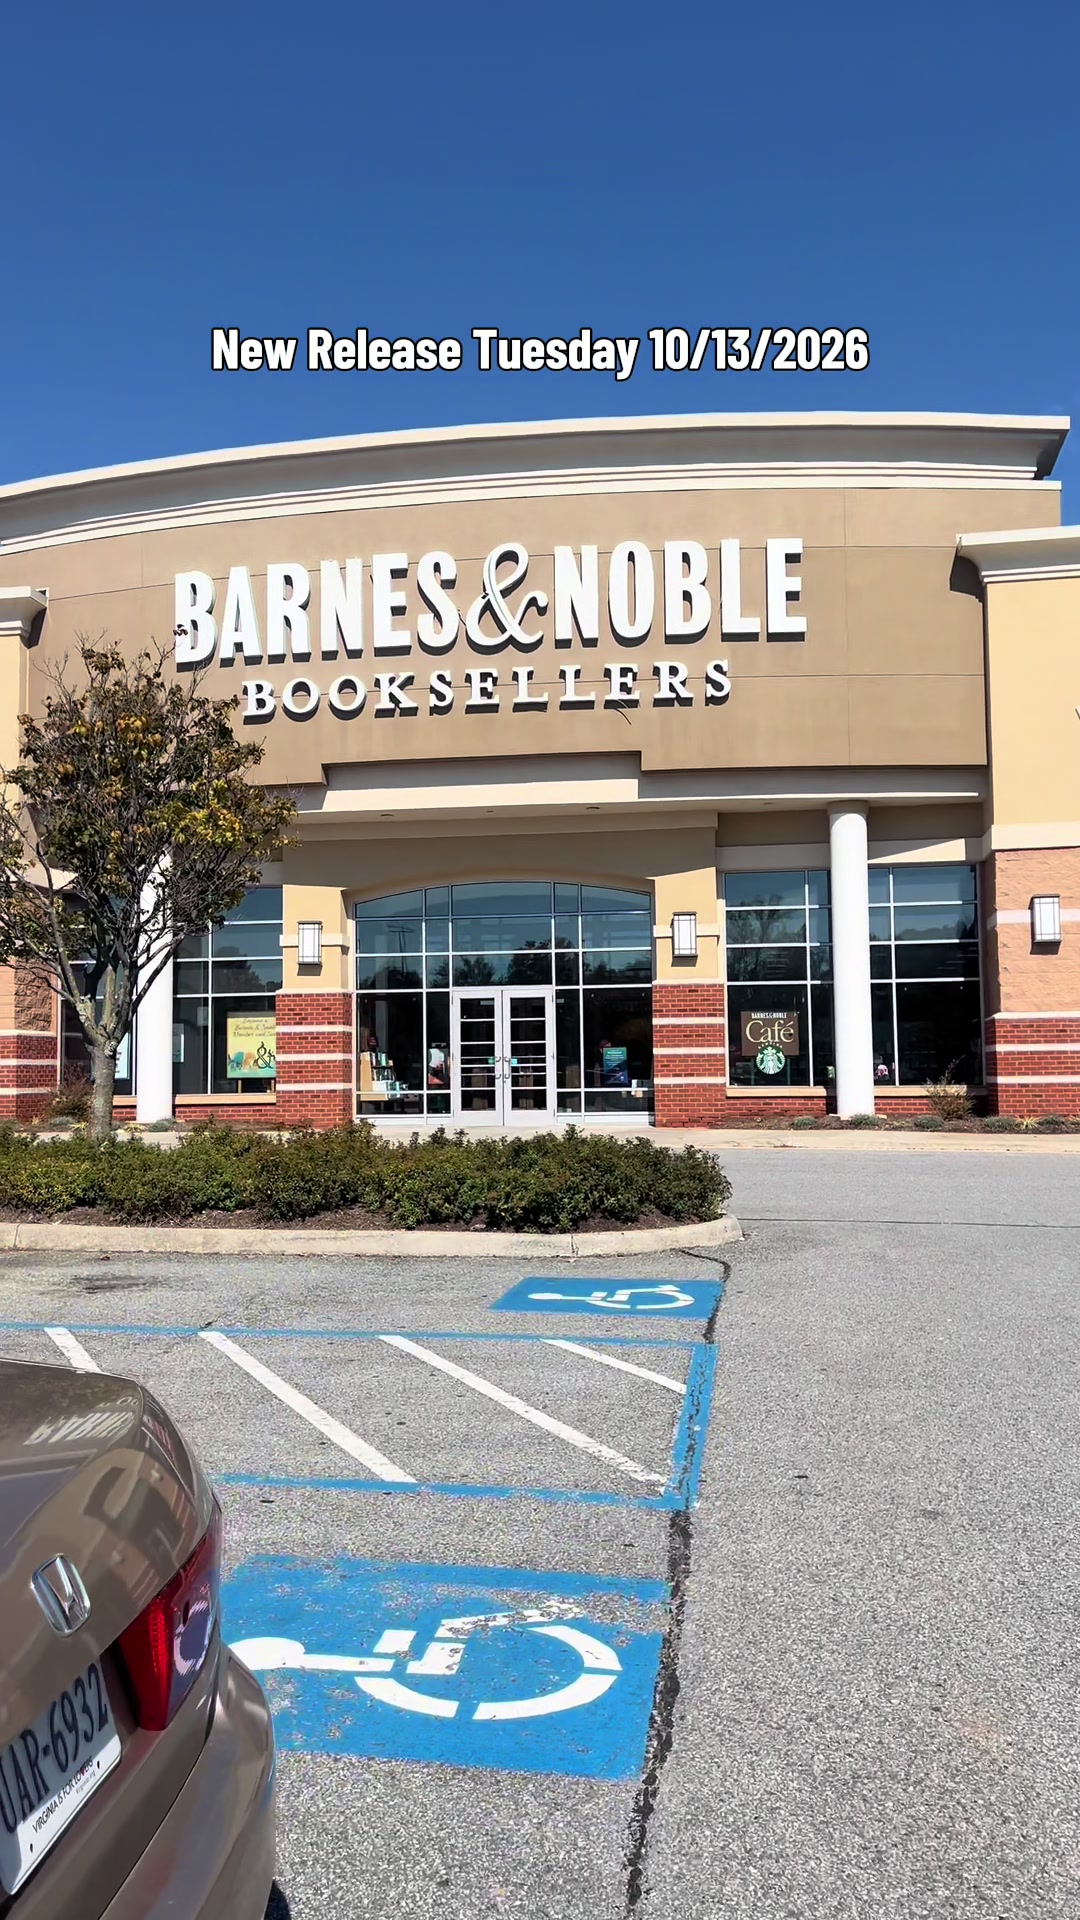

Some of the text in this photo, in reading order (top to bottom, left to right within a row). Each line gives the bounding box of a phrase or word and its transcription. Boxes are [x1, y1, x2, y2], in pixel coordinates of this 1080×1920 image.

[242, 659, 732, 723] BOOKSELLERS
[745, 1020, 794, 1043] Café
[32, 1799, 59, 1833] VIRGINIA
[62, 1779, 75, 1799] FOR
